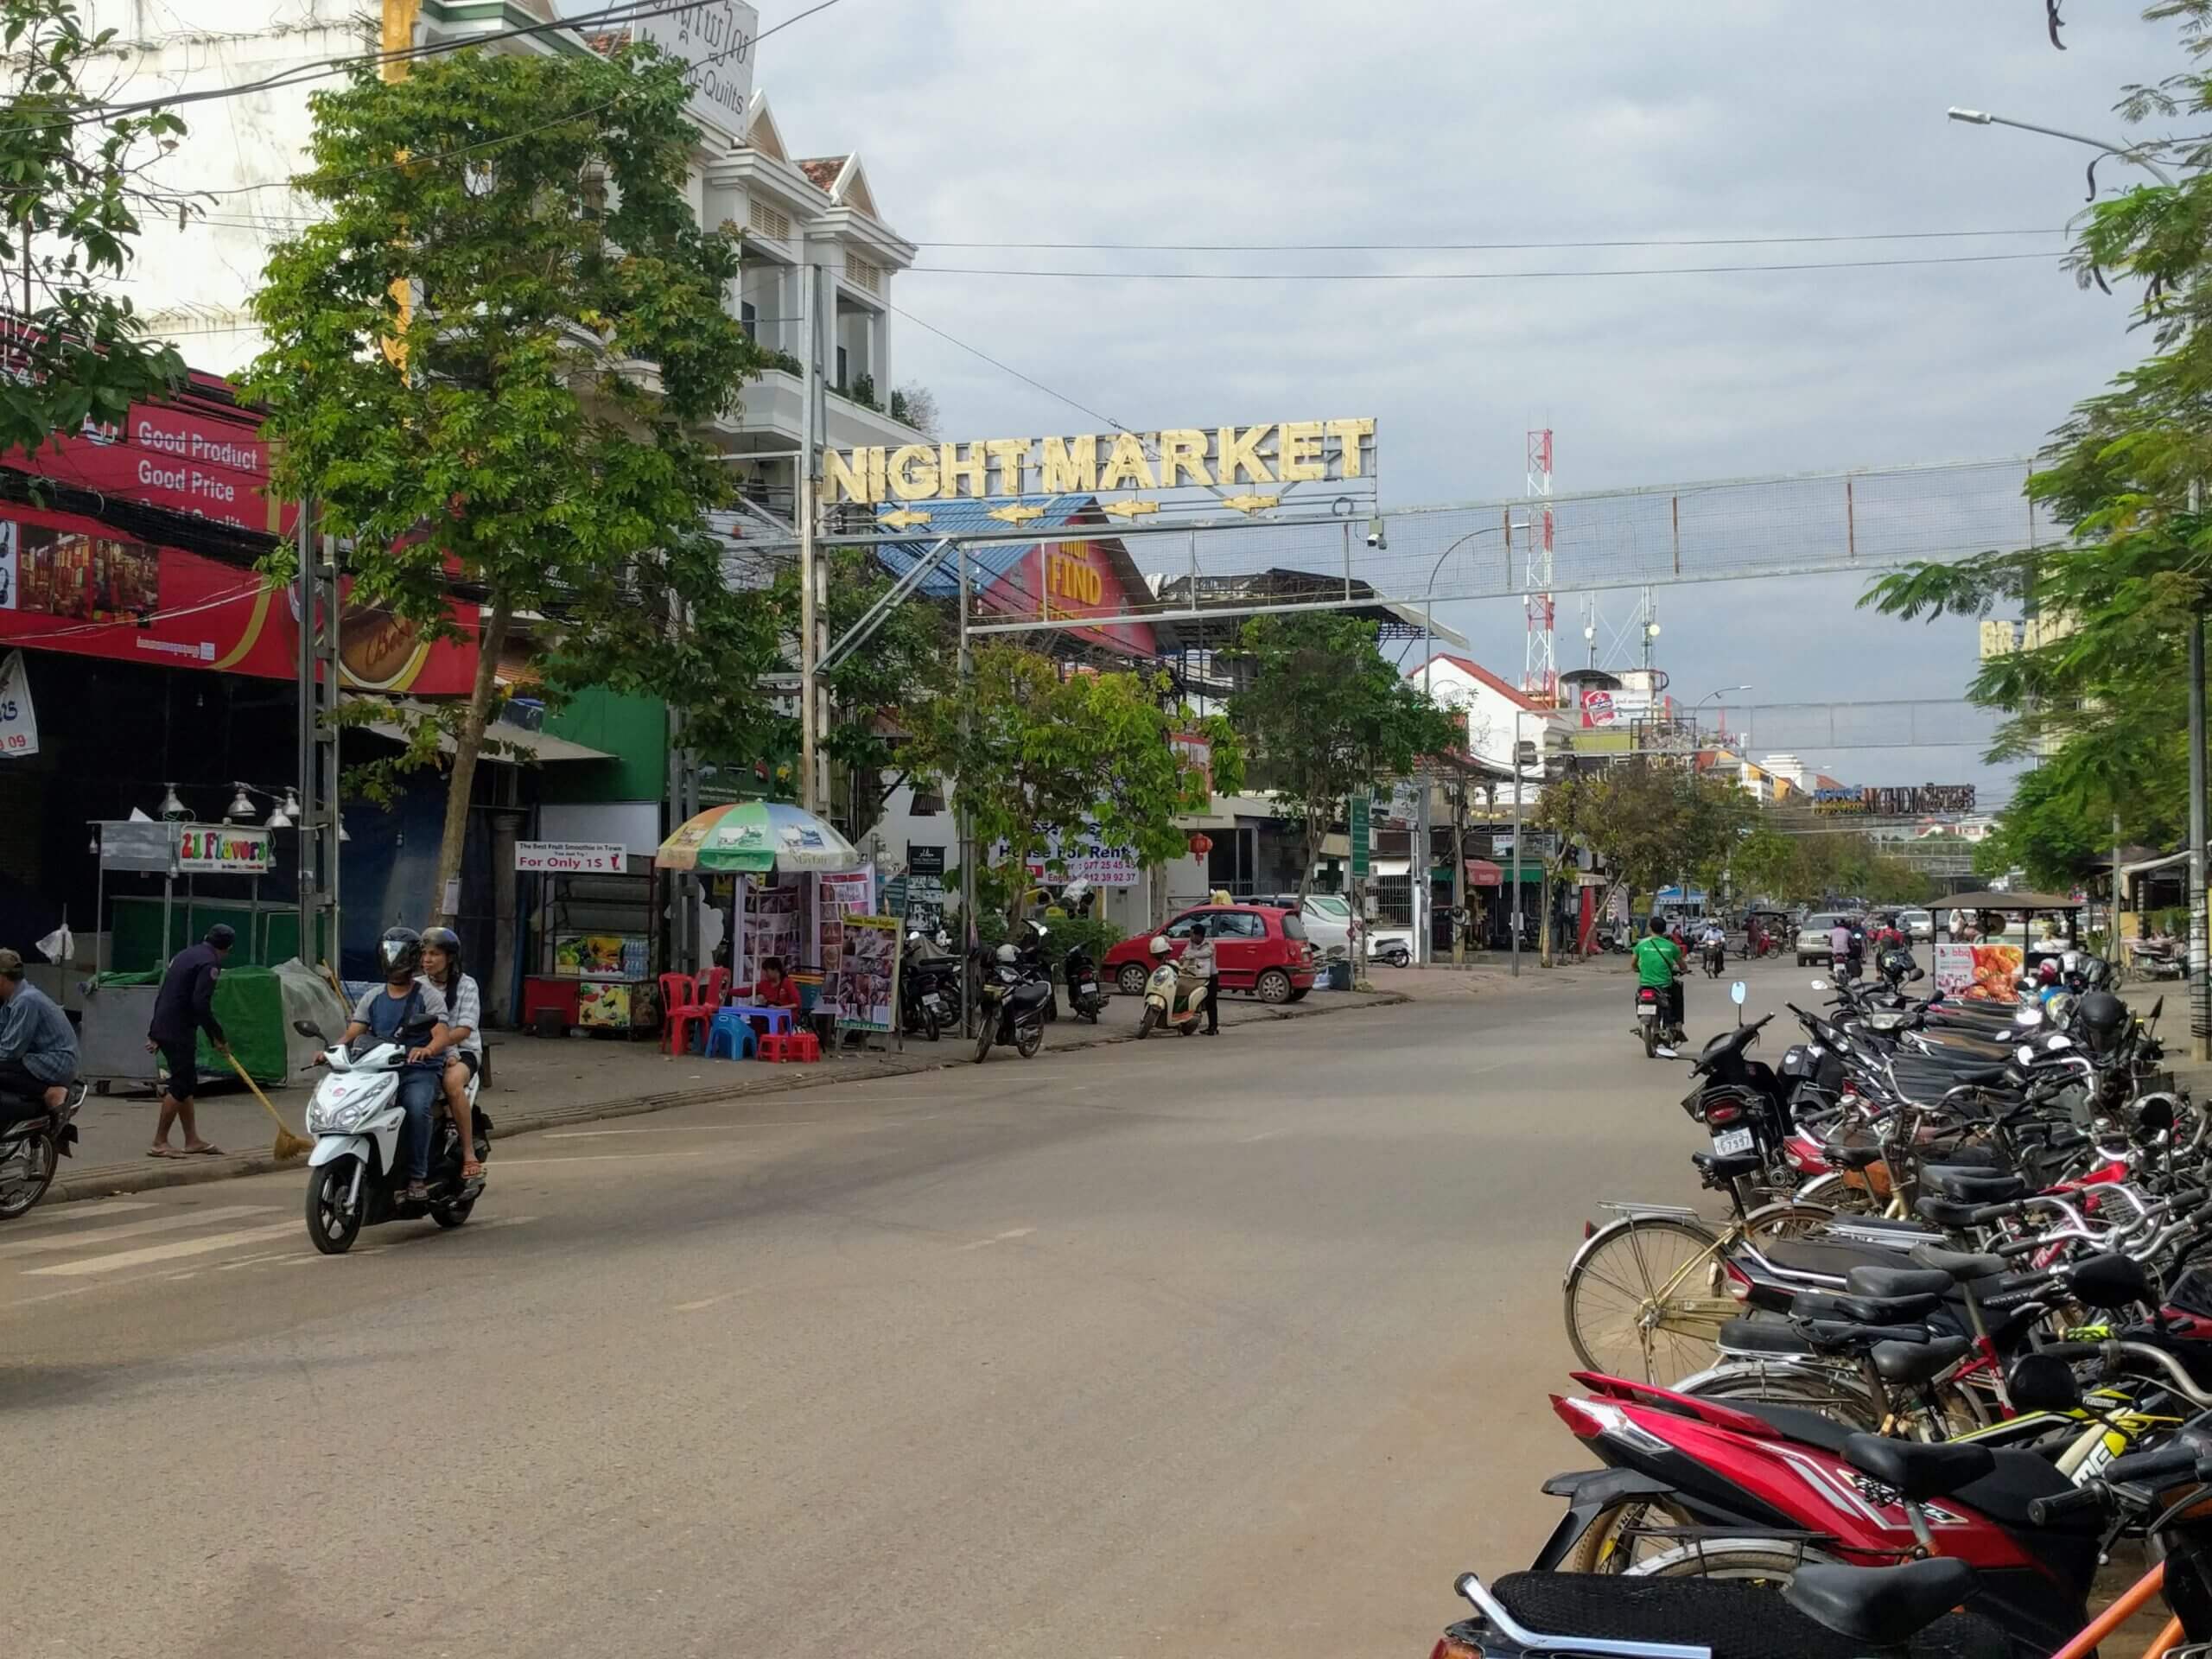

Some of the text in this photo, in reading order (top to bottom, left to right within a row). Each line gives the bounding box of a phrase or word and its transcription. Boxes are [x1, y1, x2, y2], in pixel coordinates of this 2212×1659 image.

[138, 421, 186, 454] Good
[191, 433, 257, 470] Product
[823, 416, 1376, 504] NIGHT MARKET
[137, 459, 235, 502] Good Price
[1046, 555, 1103, 606] FIND
[181, 833, 266, 861] 21 Flavors
[520, 857, 543, 867] For
[547, 857, 582, 870] Only
[1090, 846, 1128, 858] Rent
[1953, 947, 1971, 959] bbq
